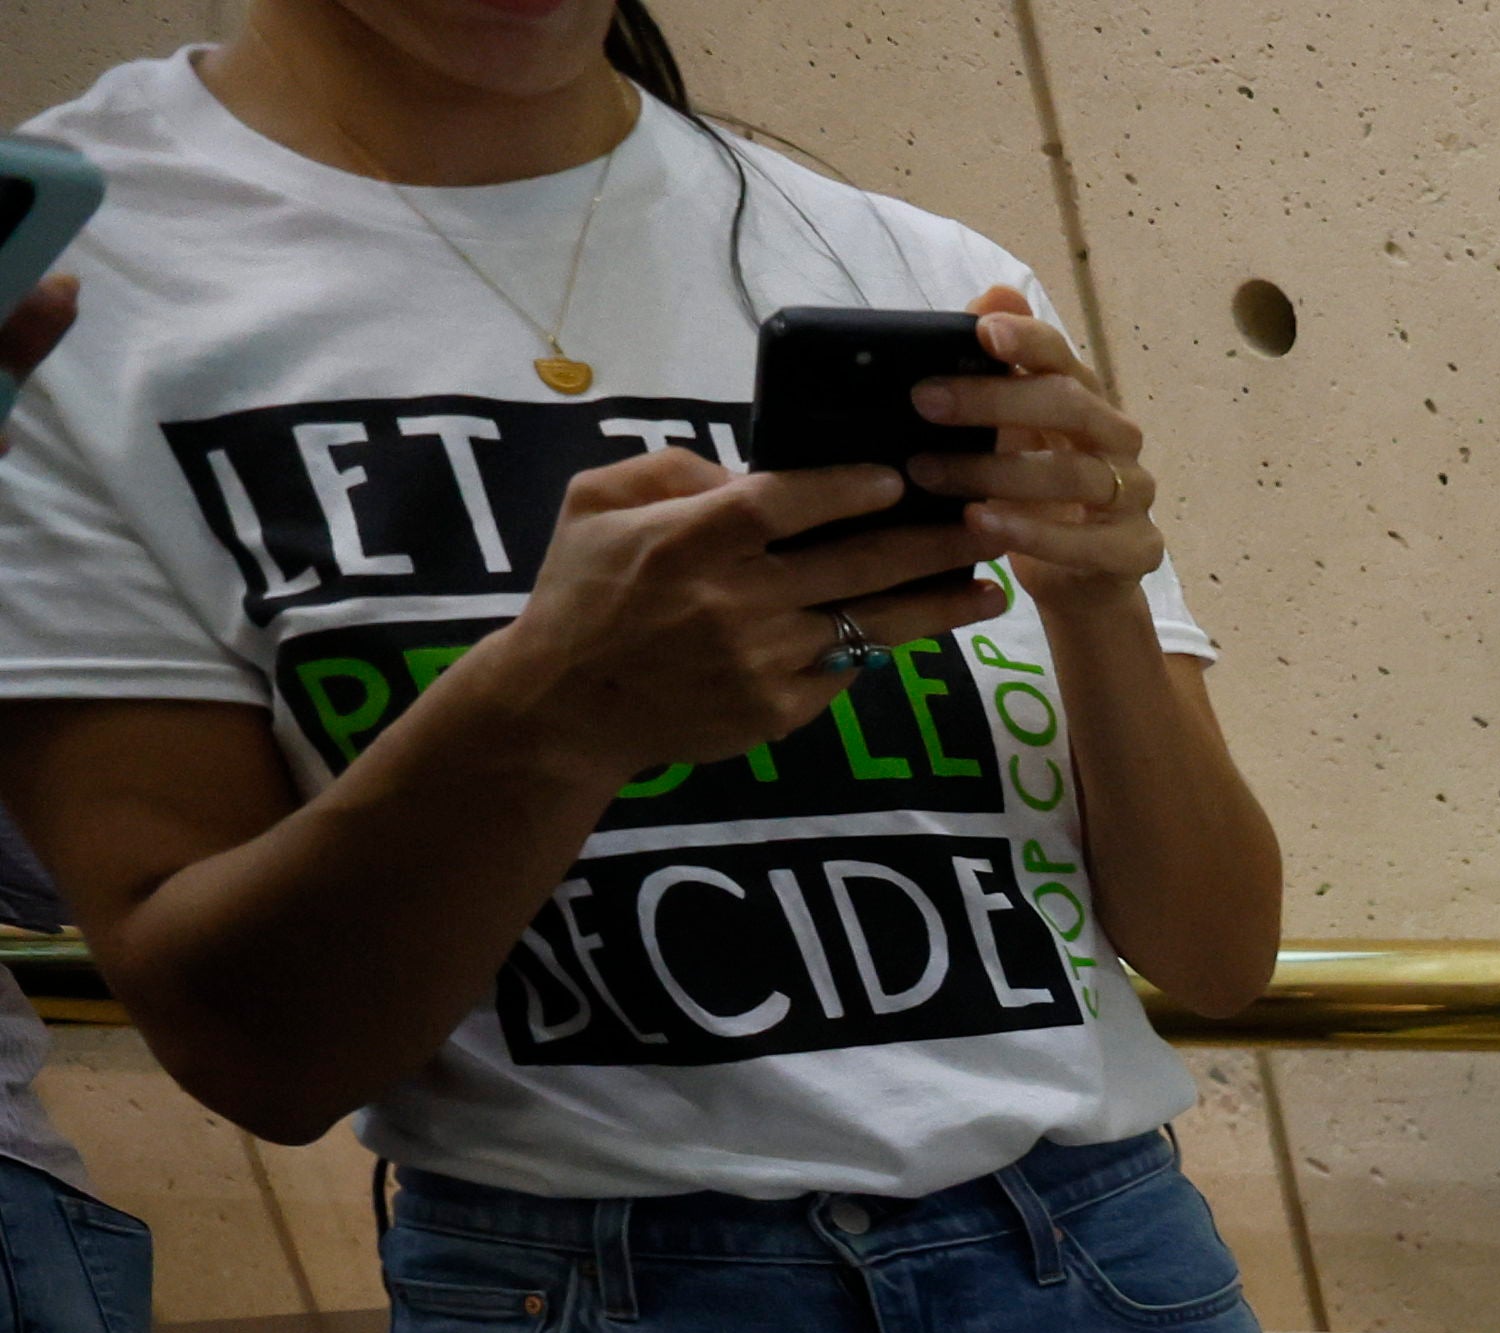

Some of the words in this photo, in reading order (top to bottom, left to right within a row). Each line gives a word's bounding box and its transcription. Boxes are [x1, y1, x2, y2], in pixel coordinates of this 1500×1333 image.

[206, 412, 513, 602] LET
[971, 634, 1064, 811] COP
[508, 856, 1054, 1044] DECIDE
